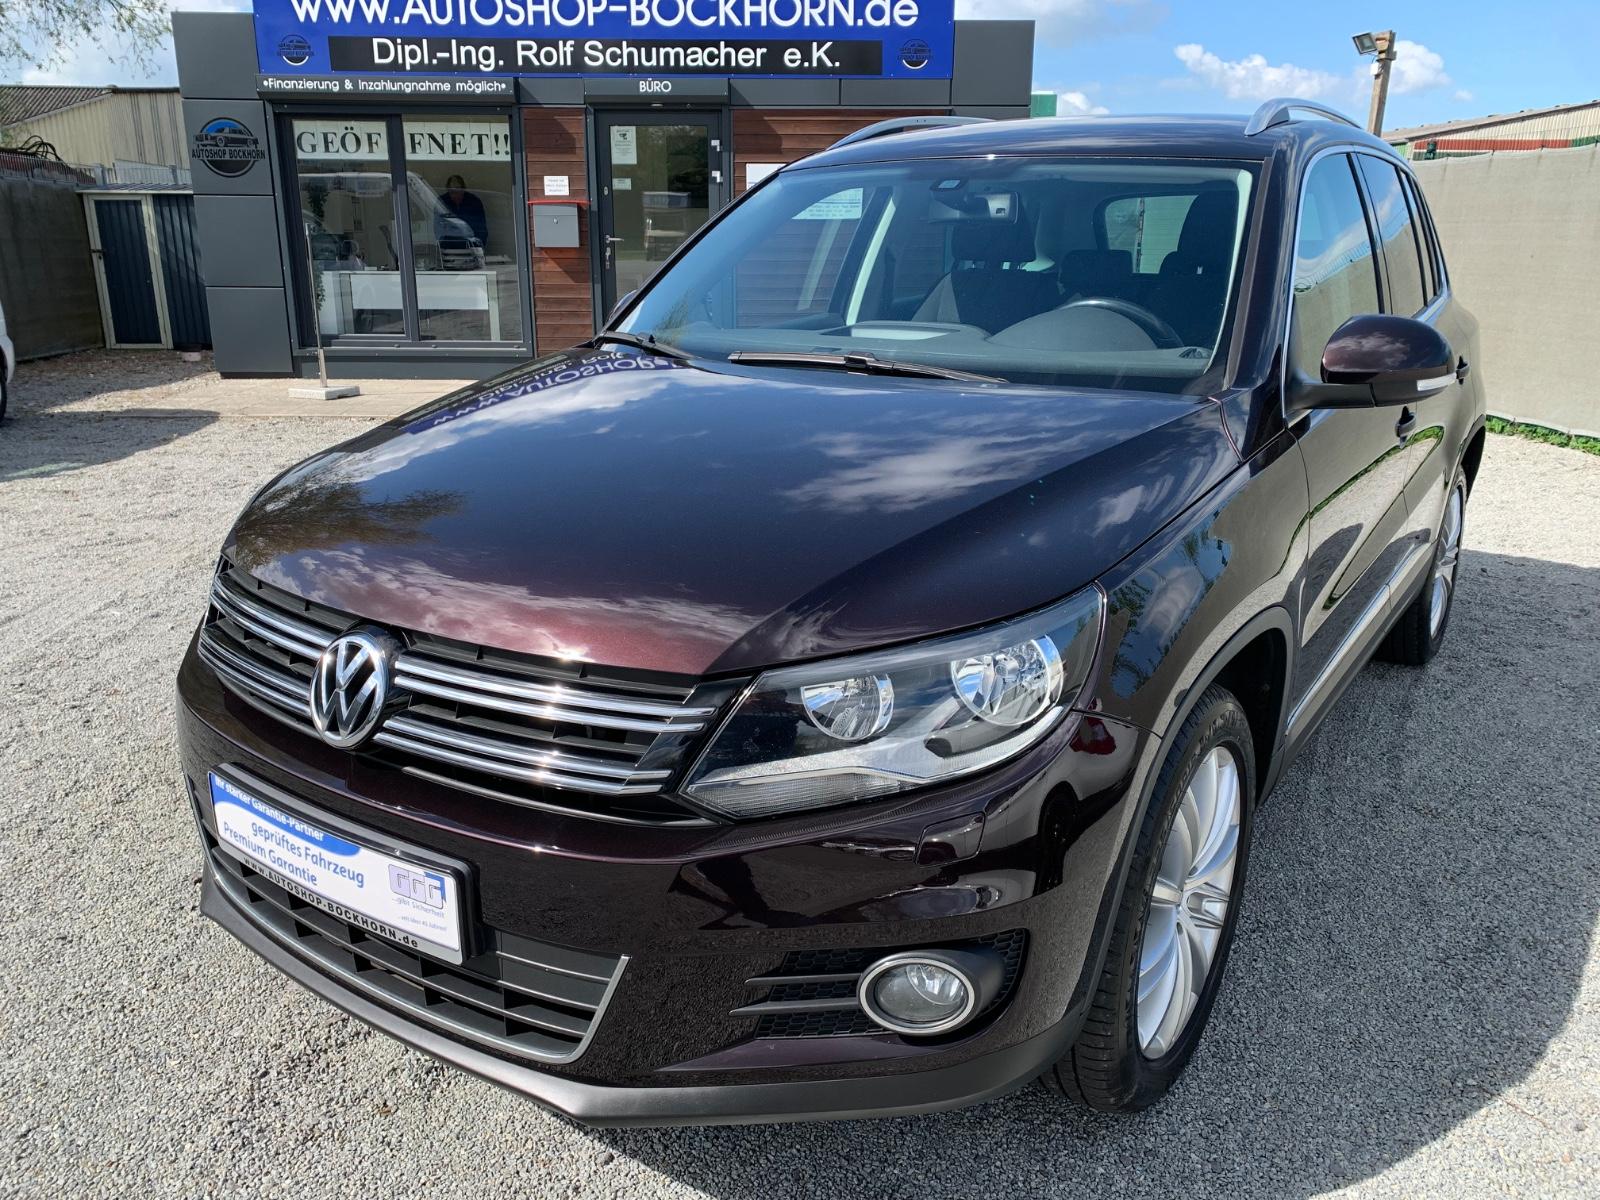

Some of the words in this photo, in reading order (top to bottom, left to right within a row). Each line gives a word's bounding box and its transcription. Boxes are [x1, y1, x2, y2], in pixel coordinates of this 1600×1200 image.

[372, 38, 504, 72] Dipl.-Ing.
[516, 39, 574, 66] Rolf
[584, 40, 767, 67] Schumacher
[783, 42, 841, 68] e.K.
[344, 79, 354, 91] &
[358, 79, 451, 95] Inzahlungnahme
[639, 78, 672, 92] BÜRO
[192, 147, 227, 159] AUTOSHOP
[228, 148, 266, 160] BOCKHORN
[251, 798, 325, 842] Garantie-Partner
[223, 820, 267, 860] Premium
[267, 848, 319, 887] Garantie
[251, 821, 303, 858] geprüftes
[304, 845, 365, 889] Fahrzeug
[243, 856, 419, 948] www.AUTOSHOP-BOCKHORN.de
